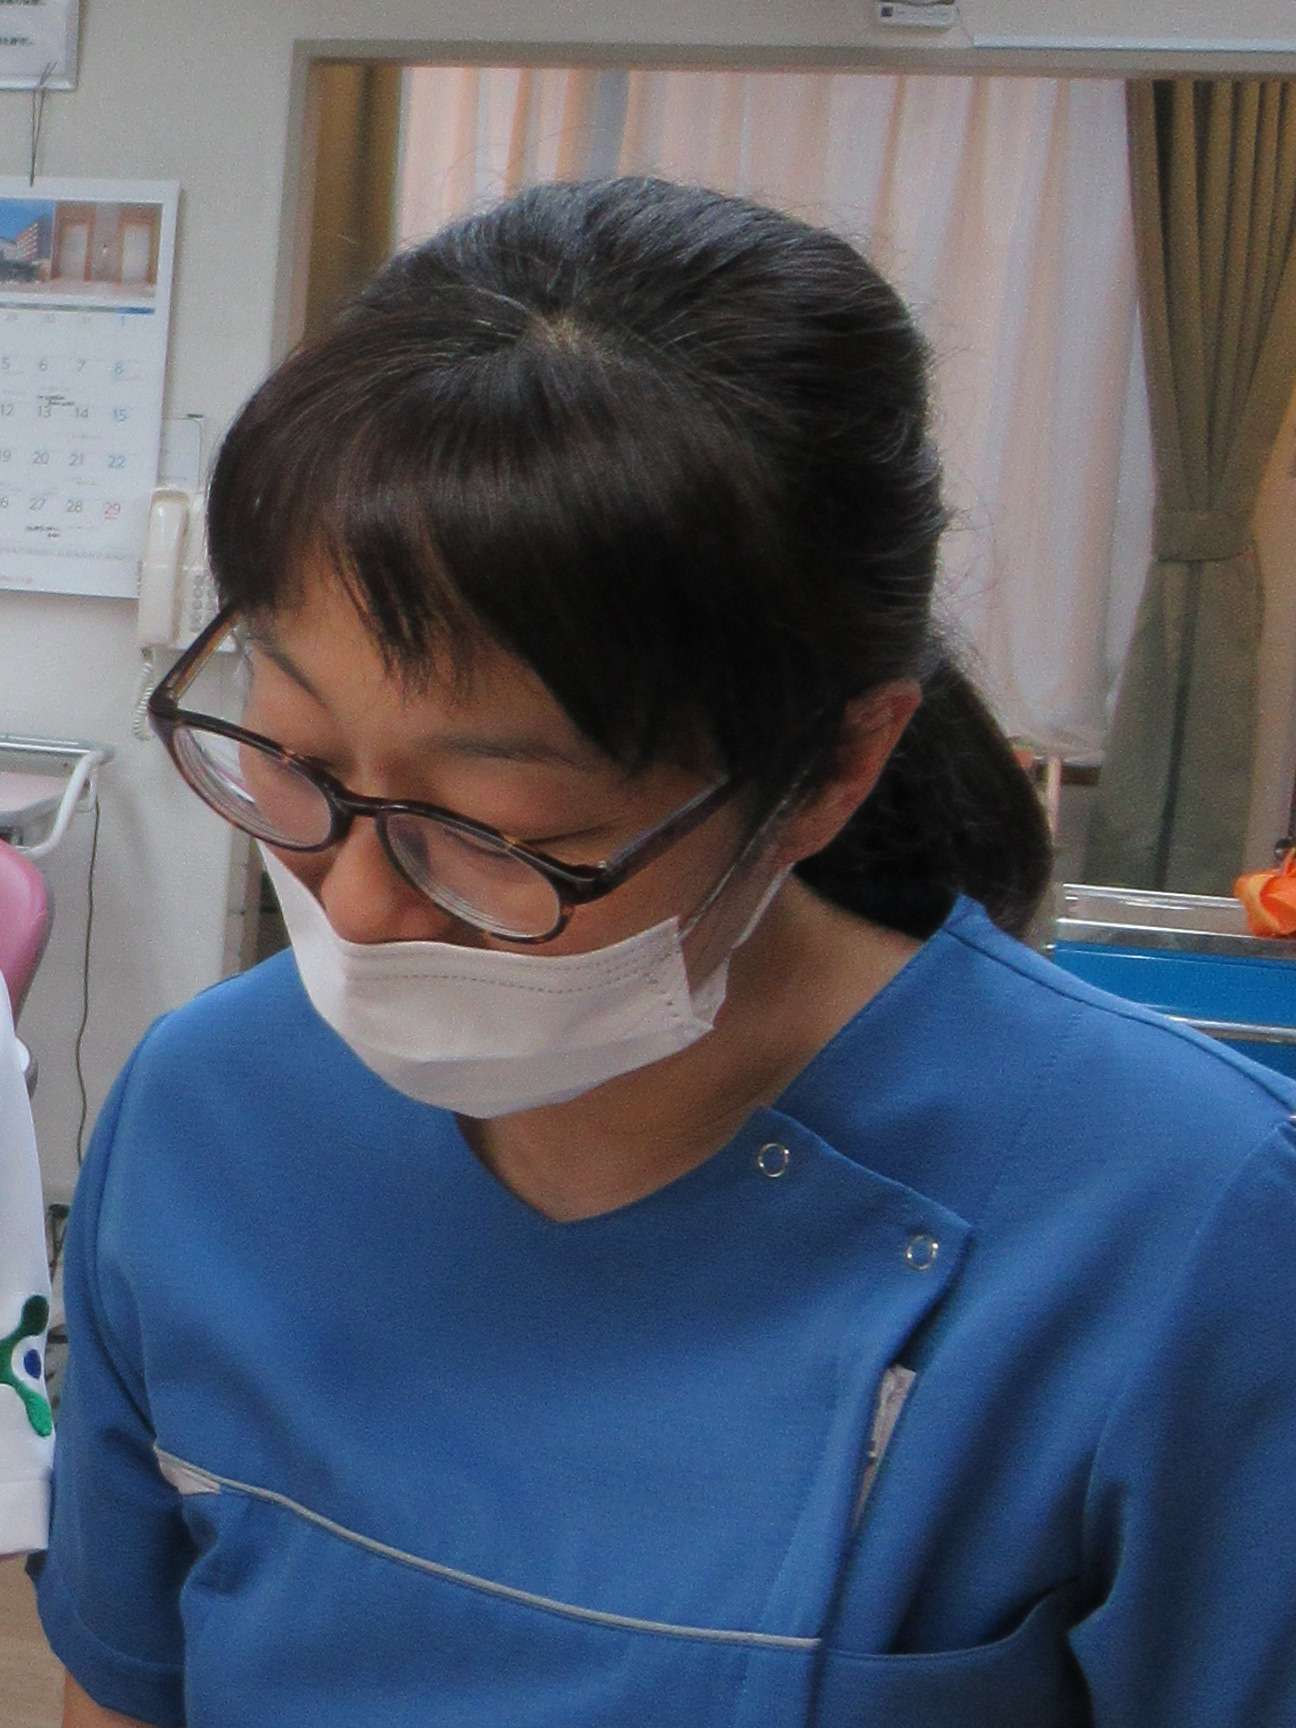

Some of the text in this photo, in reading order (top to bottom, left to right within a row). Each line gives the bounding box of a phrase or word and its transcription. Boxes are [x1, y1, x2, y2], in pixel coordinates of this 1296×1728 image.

[0, 404, 15, 417] 12
[37, 406, 52, 419] 13
[75, 406, 90, 419] 14
[112, 408, 128, 422] 15
[32, 451, 50, 465] 20
[69, 452, 85, 466] 21
[108, 455, 126, 469] 22
[29, 497, 47, 511] 27
[66, 499, 83, 513] 28
[104, 502, 121, 515] 29
